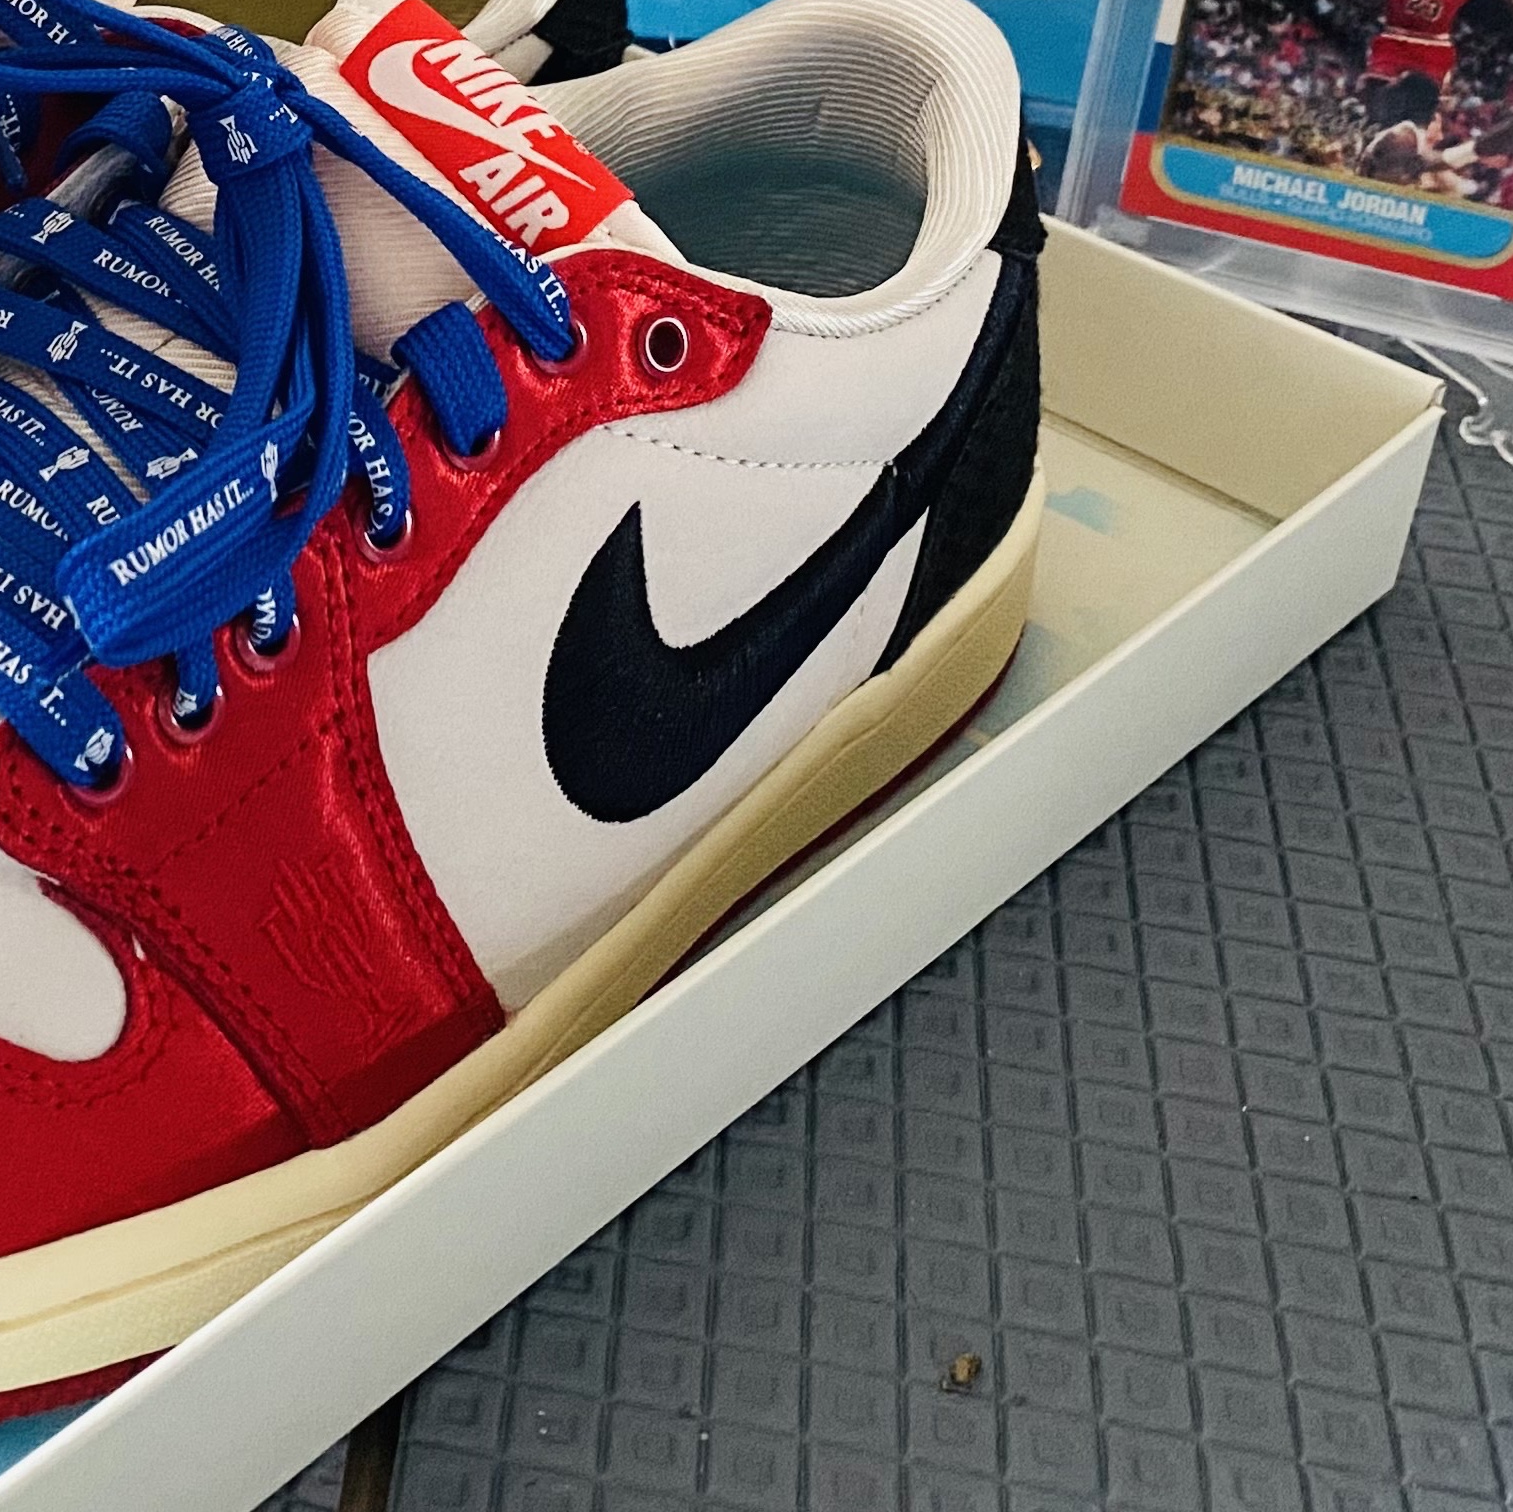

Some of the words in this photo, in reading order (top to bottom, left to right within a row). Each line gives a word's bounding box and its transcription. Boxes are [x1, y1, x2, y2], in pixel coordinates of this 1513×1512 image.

[226, 33, 254, 57] HAS
[421, 38, 564, 148] NIKE
[458, 152, 570, 248] AIR
[1232, 163, 1330, 205] MICHAEL
[1338, 188, 1430, 227] JORDAN
[144, 215, 204, 267] RUMOR
[536, 271, 566, 323] IT...
[99, 347, 141, 381] IT...
[140, 371, 196, 410] HAS
[17, 415, 46, 448] IT...
[364, 454, 394, 517] HAS
[107, 517, 190, 587] RUMOR
[187, 492, 227, 537] HAS
[223, 478, 255, 510] IT...
[12, 584, 68, 632] HAS
